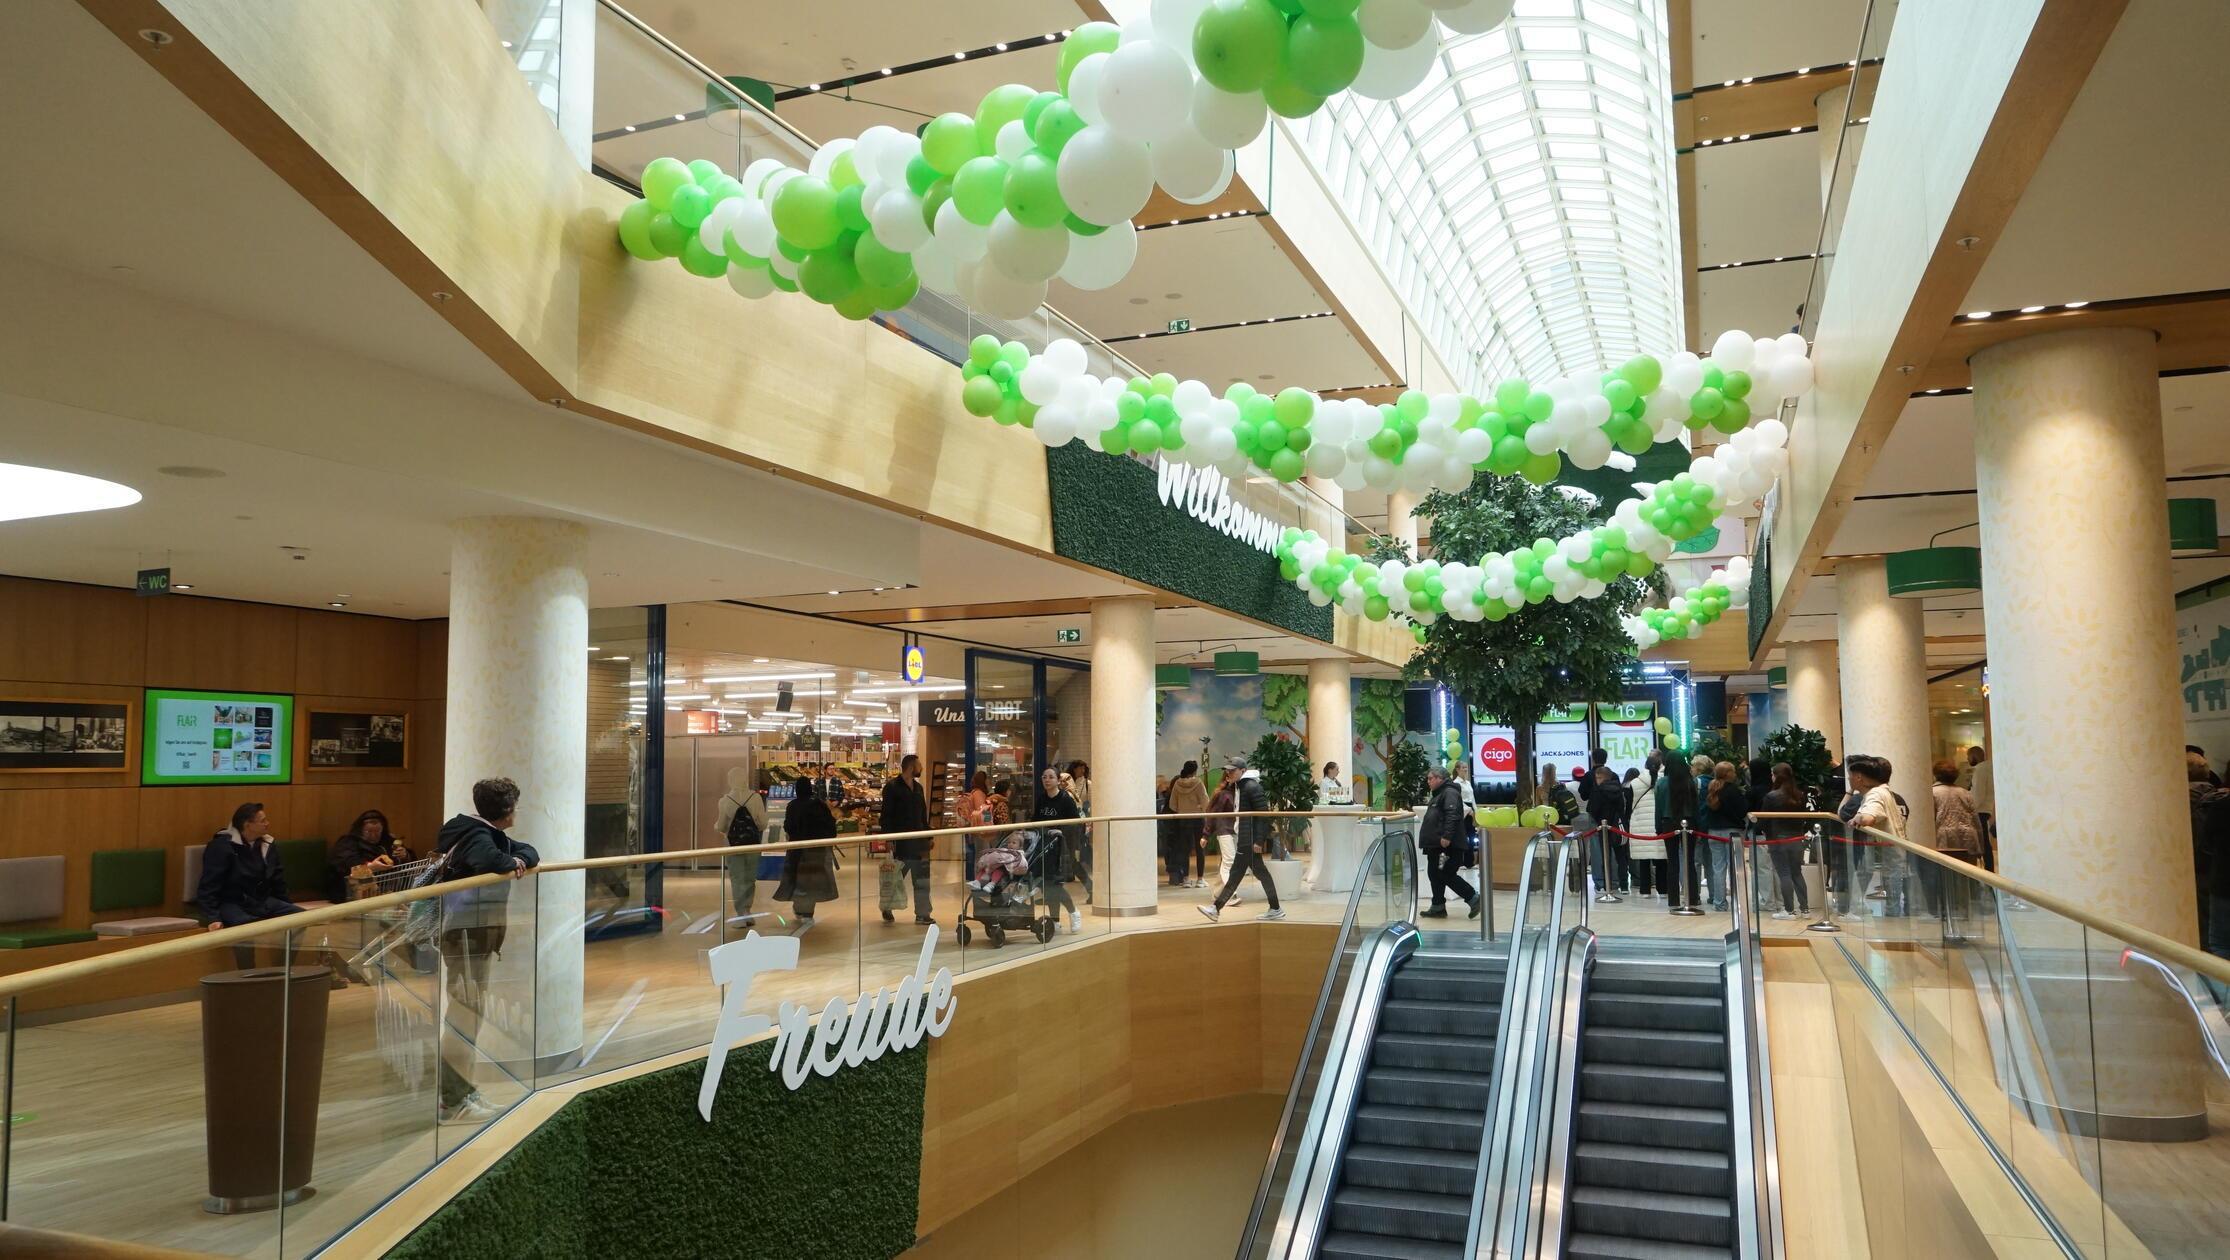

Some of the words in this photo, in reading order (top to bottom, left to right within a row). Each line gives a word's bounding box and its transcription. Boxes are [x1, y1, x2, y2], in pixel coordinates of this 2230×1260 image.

[148, 575, 167, 590] WC
[985, 700, 1022, 721] BROT
[1616, 703, 1636, 719] 16
[1483, 748, 1512, 762] cigo
[1603, 736, 1650, 760] FLAIR
[697, 923, 958, 1123] Freude
